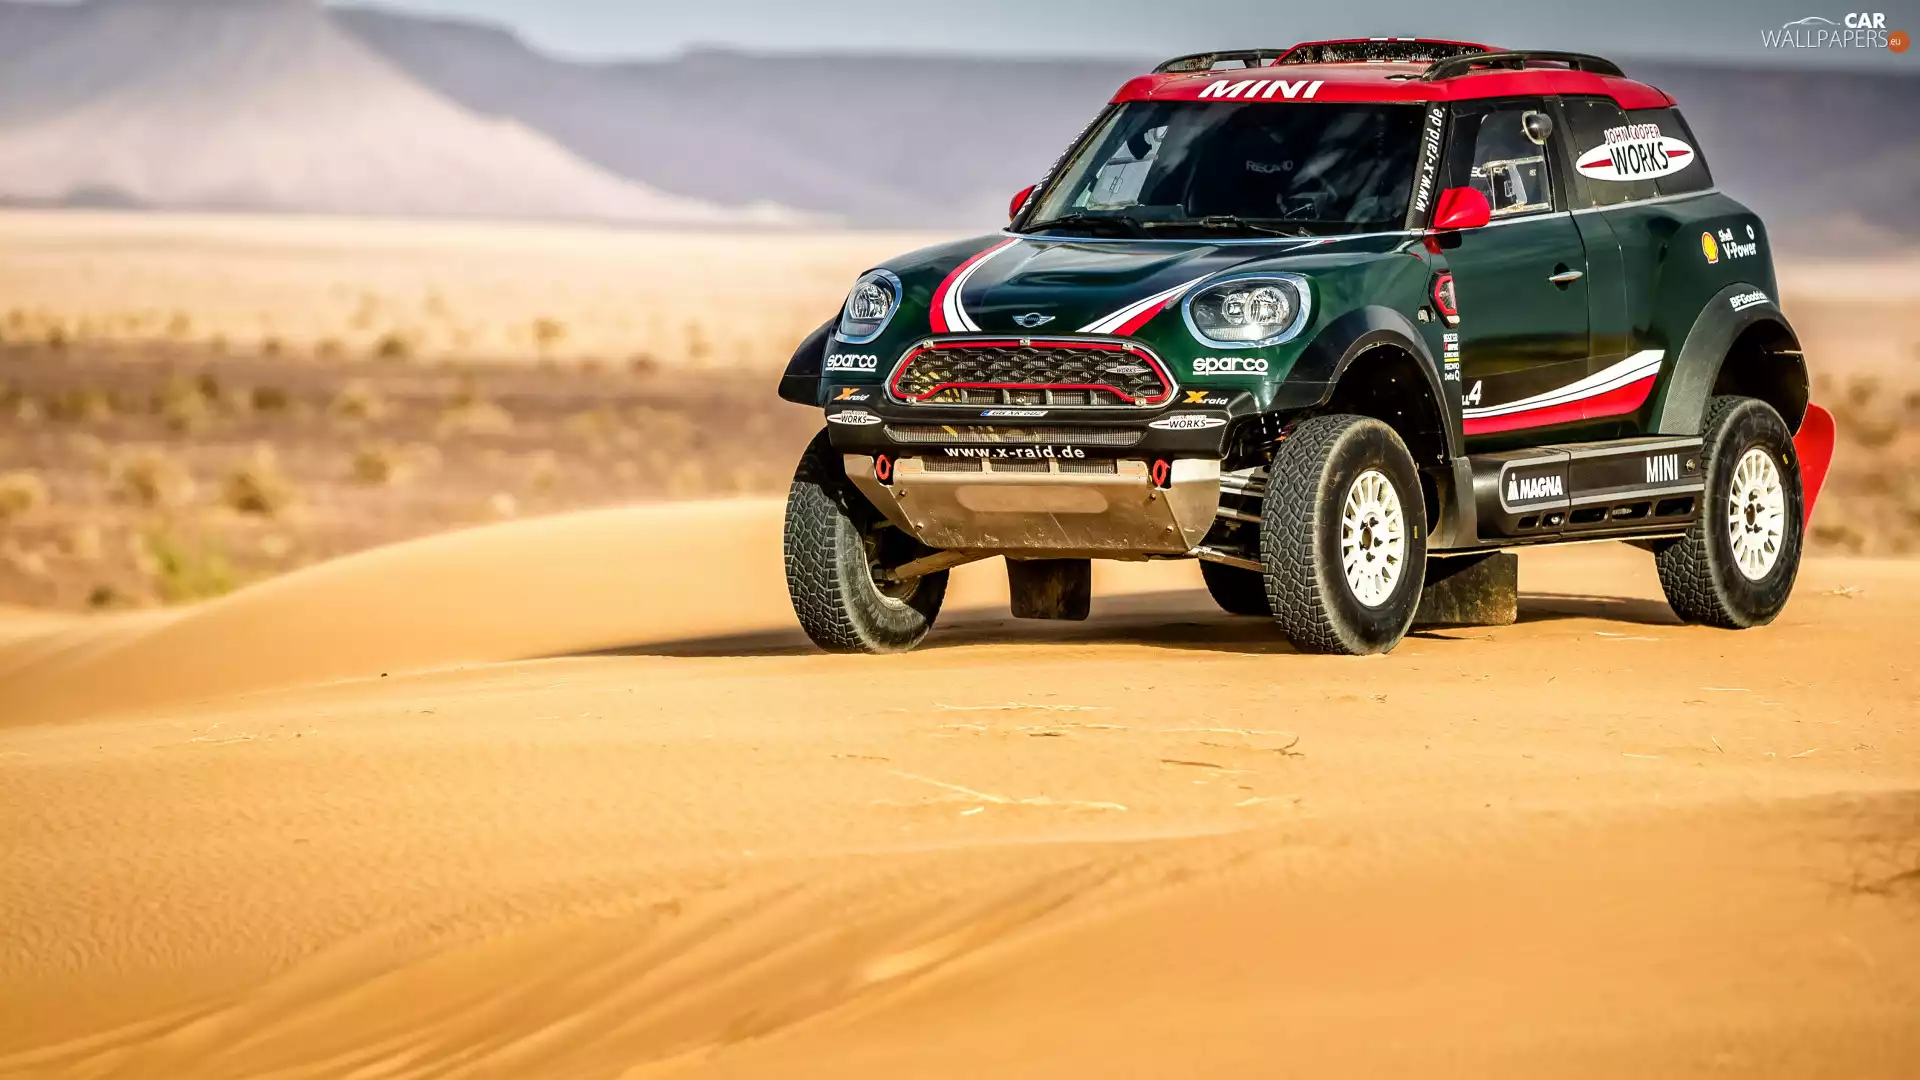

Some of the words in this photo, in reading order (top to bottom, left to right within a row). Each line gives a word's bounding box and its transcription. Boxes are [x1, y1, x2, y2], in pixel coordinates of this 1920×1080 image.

[1198, 79, 1325, 99] MINI
[1604, 126, 1628, 145] JOHN
[1610, 141, 1669, 175] WORKS
[1722, 241, 1757, 259] V-Power
[826, 353, 878, 371] sparco
[1193, 357, 1269, 375] sparco
[841, 415, 868, 424] WORKS
[1169, 420, 1206, 428] WORKS
[944, 445, 1086, 458] www.x-raid.de
[1646, 454, 1679, 483] MINI
[1519, 475, 1564, 500] MAGNA
